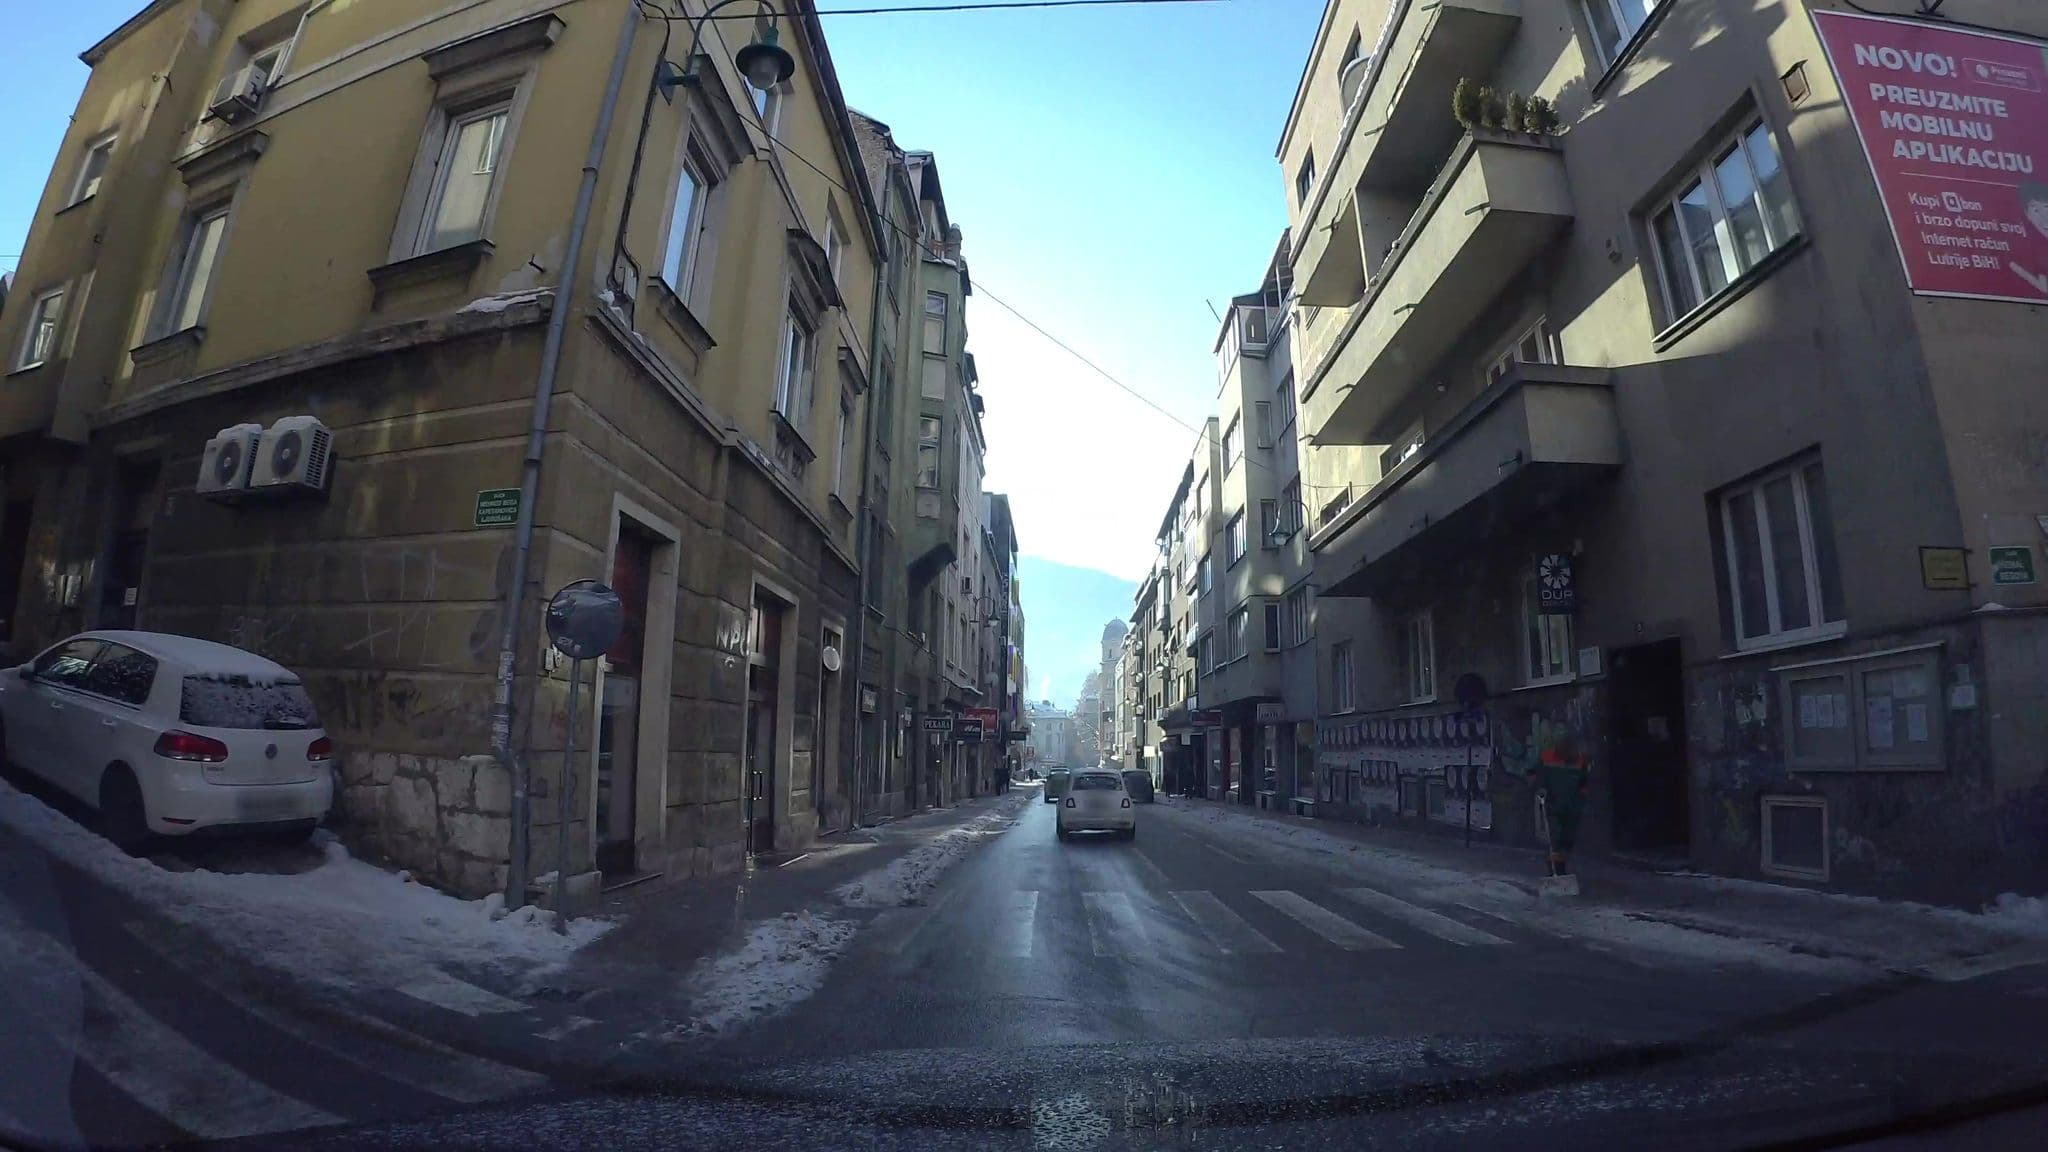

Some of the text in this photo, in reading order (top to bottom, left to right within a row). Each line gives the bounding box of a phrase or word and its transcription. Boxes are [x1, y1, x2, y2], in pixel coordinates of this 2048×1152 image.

[1854, 43, 1957, 78] NOVO!
[1869, 83, 2009, 118] PREUZMITE
[1880, 110, 1993, 142] MOBILNU
[1893, 139, 2033, 174] APLIKACIJU
[1908, 192, 1940, 209] Kupi
[1922, 213, 1951, 227] brzo
[1954, 216, 1998, 232] dopuni
[2000, 222, 2027, 237] svoj
[1921, 231, 1971, 248] Internet
[1927, 251, 1970, 269] Lutrije
[924, 720, 951, 729] PEKARA
